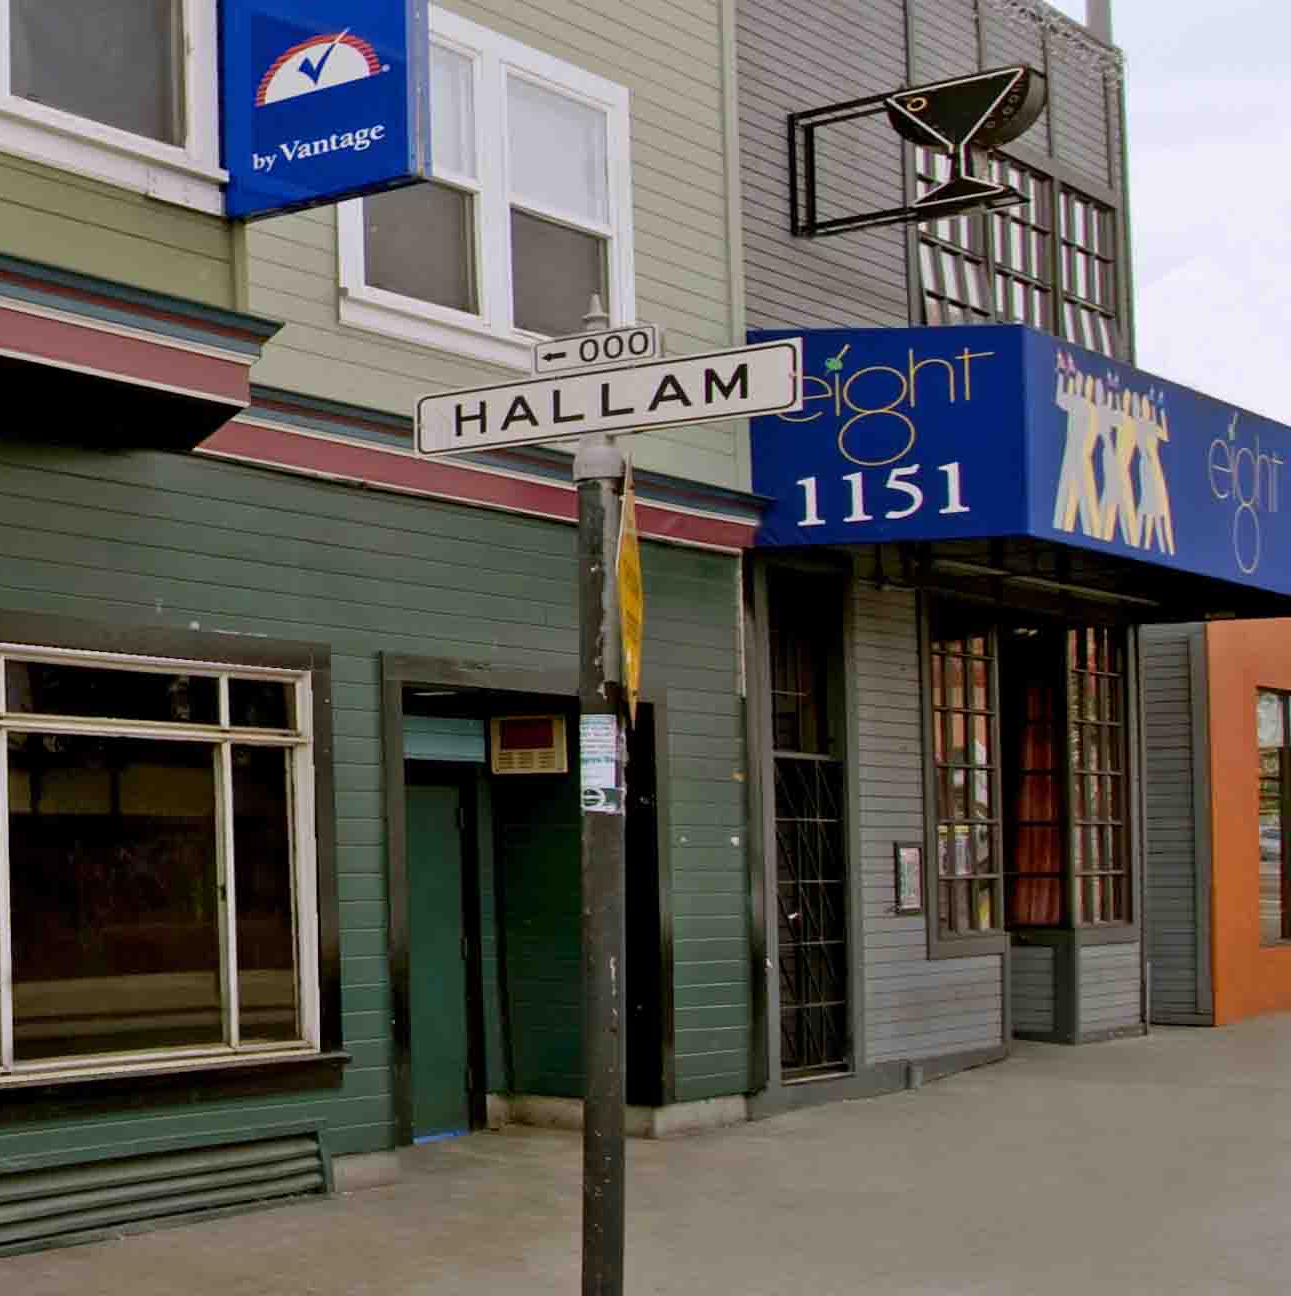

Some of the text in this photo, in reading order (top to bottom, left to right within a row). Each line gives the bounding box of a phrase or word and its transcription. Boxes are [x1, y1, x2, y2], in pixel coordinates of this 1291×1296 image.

[251, 122, 386, 173] by Vantage
[453, 362, 749, 437] HALLAM
[795, 461, 971, 527] 1151
